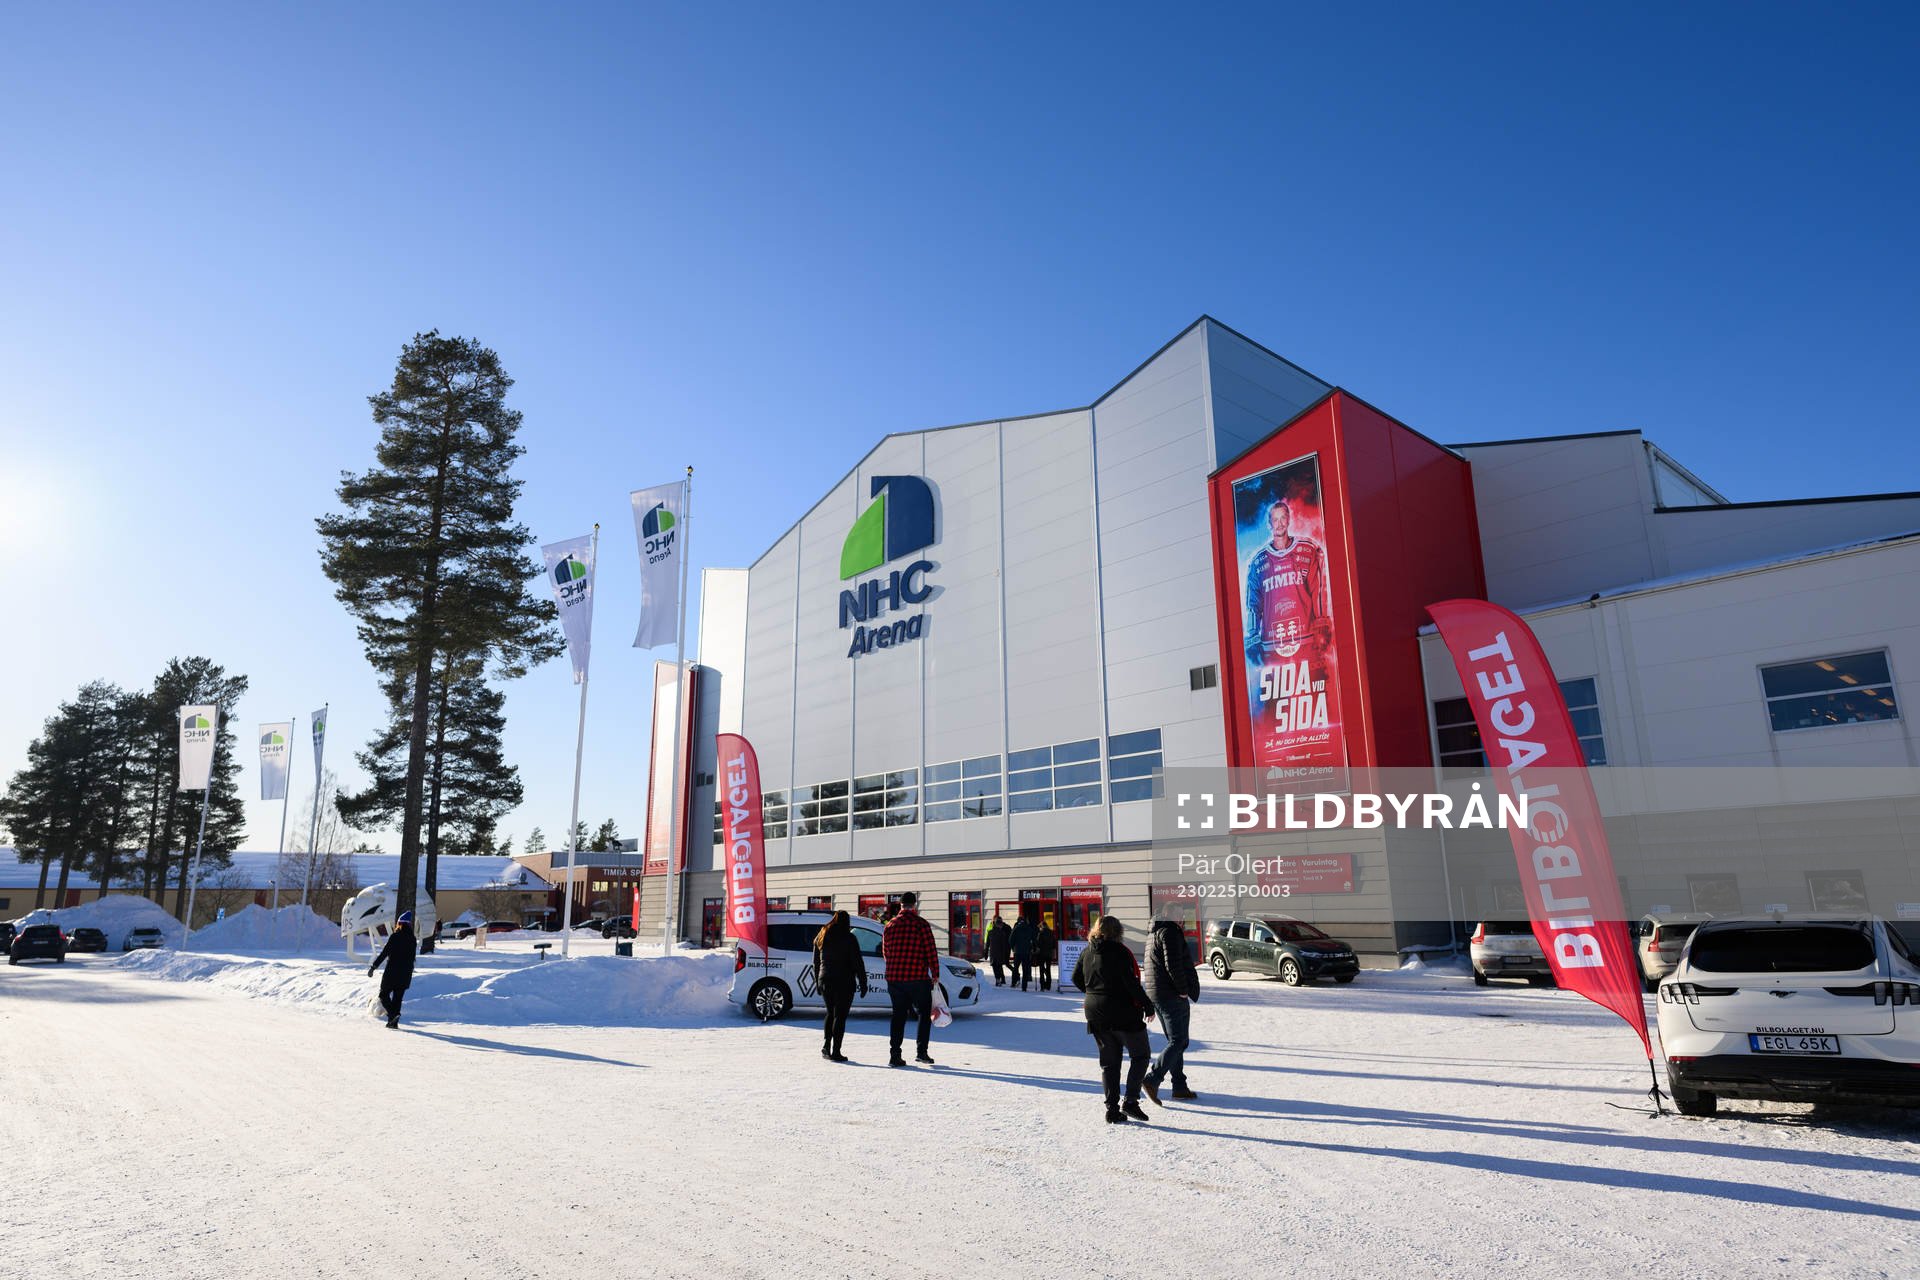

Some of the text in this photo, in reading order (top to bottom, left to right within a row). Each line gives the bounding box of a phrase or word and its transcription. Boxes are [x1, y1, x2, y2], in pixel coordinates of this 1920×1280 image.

[839, 560, 934, 629] NHC
[847, 614, 923, 658] Arena
[1258, 660, 1325, 702] SIDA VID
[1275, 692, 1329, 733] SIDA
[1284, 766, 1333, 777] NHC Arena
[1302, 859, 1338, 868] Varuintag
[1756, 1026, 1825, 1035] BILBOLAGET.NU
[1764, 1037, 1832, 1051] EGL 65K
